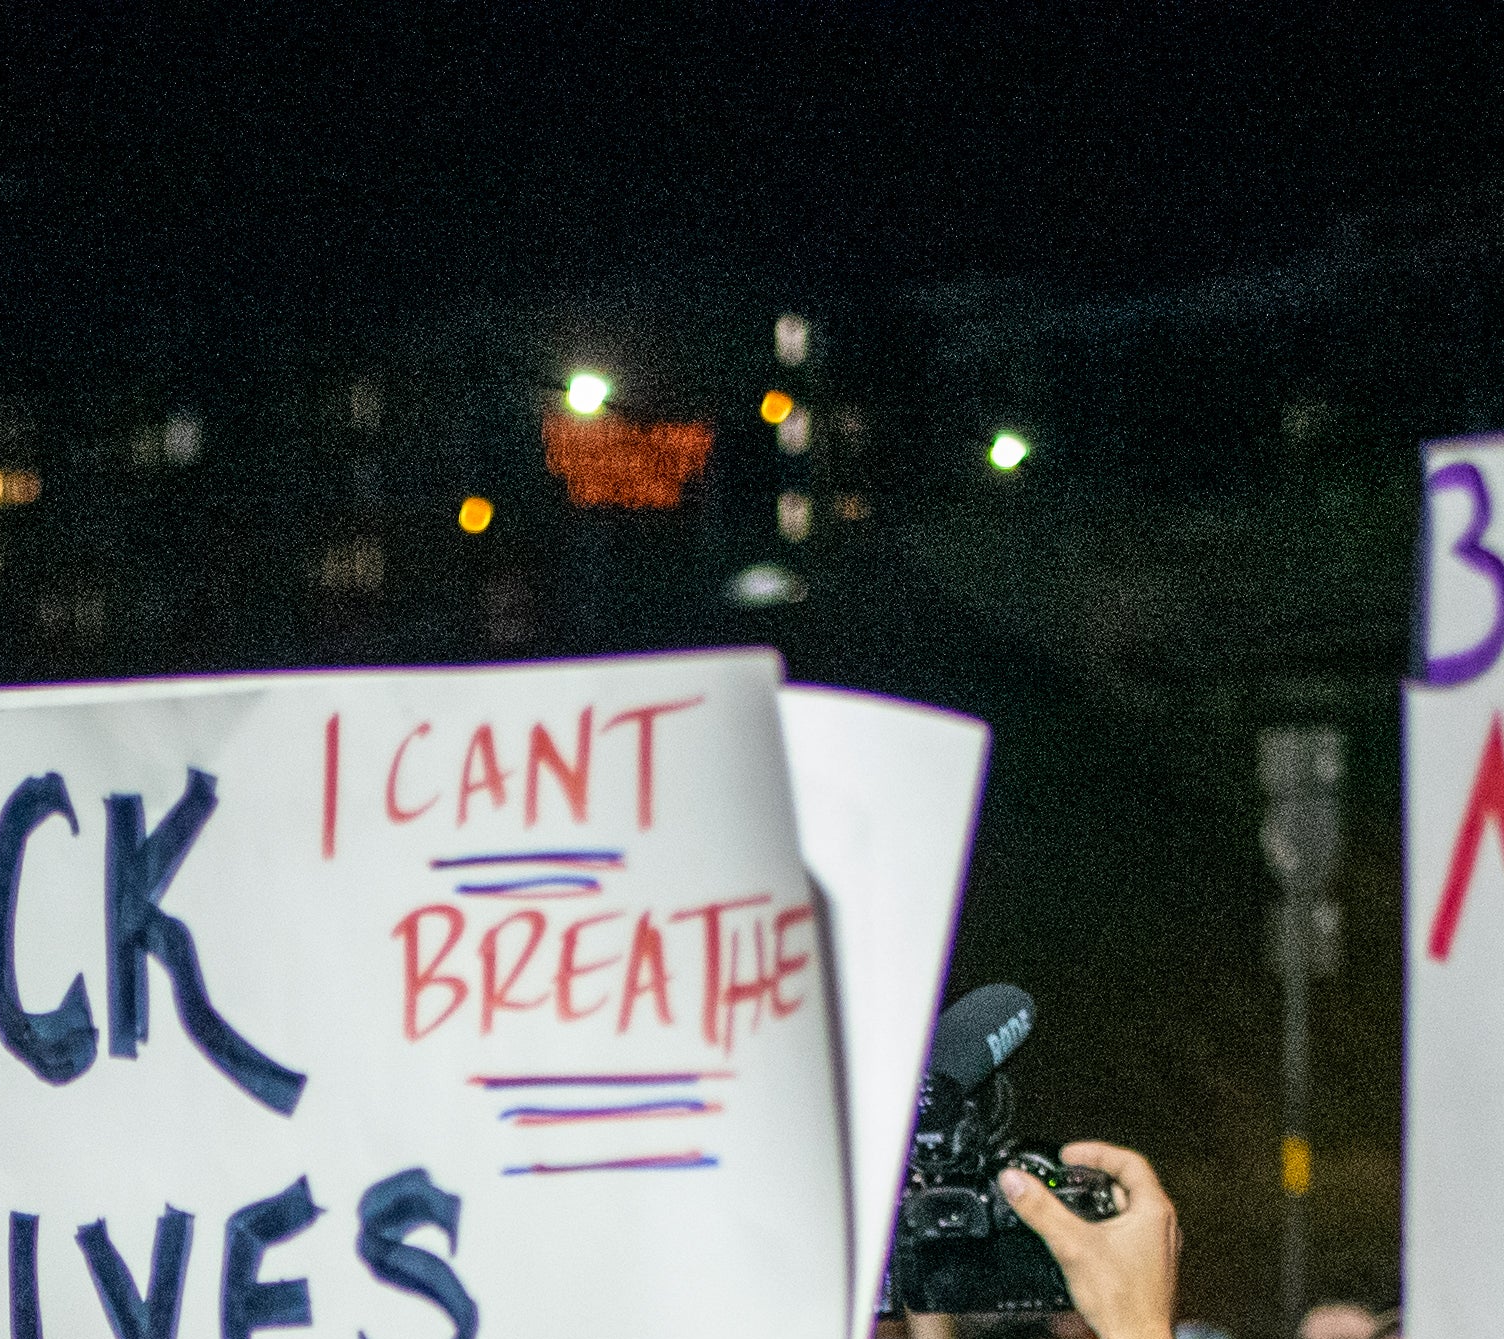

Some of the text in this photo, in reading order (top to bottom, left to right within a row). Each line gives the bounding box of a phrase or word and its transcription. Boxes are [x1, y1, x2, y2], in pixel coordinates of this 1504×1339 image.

[322, 695, 705, 859] I CANT
[391, 891, 816, 1050] BREATHE
